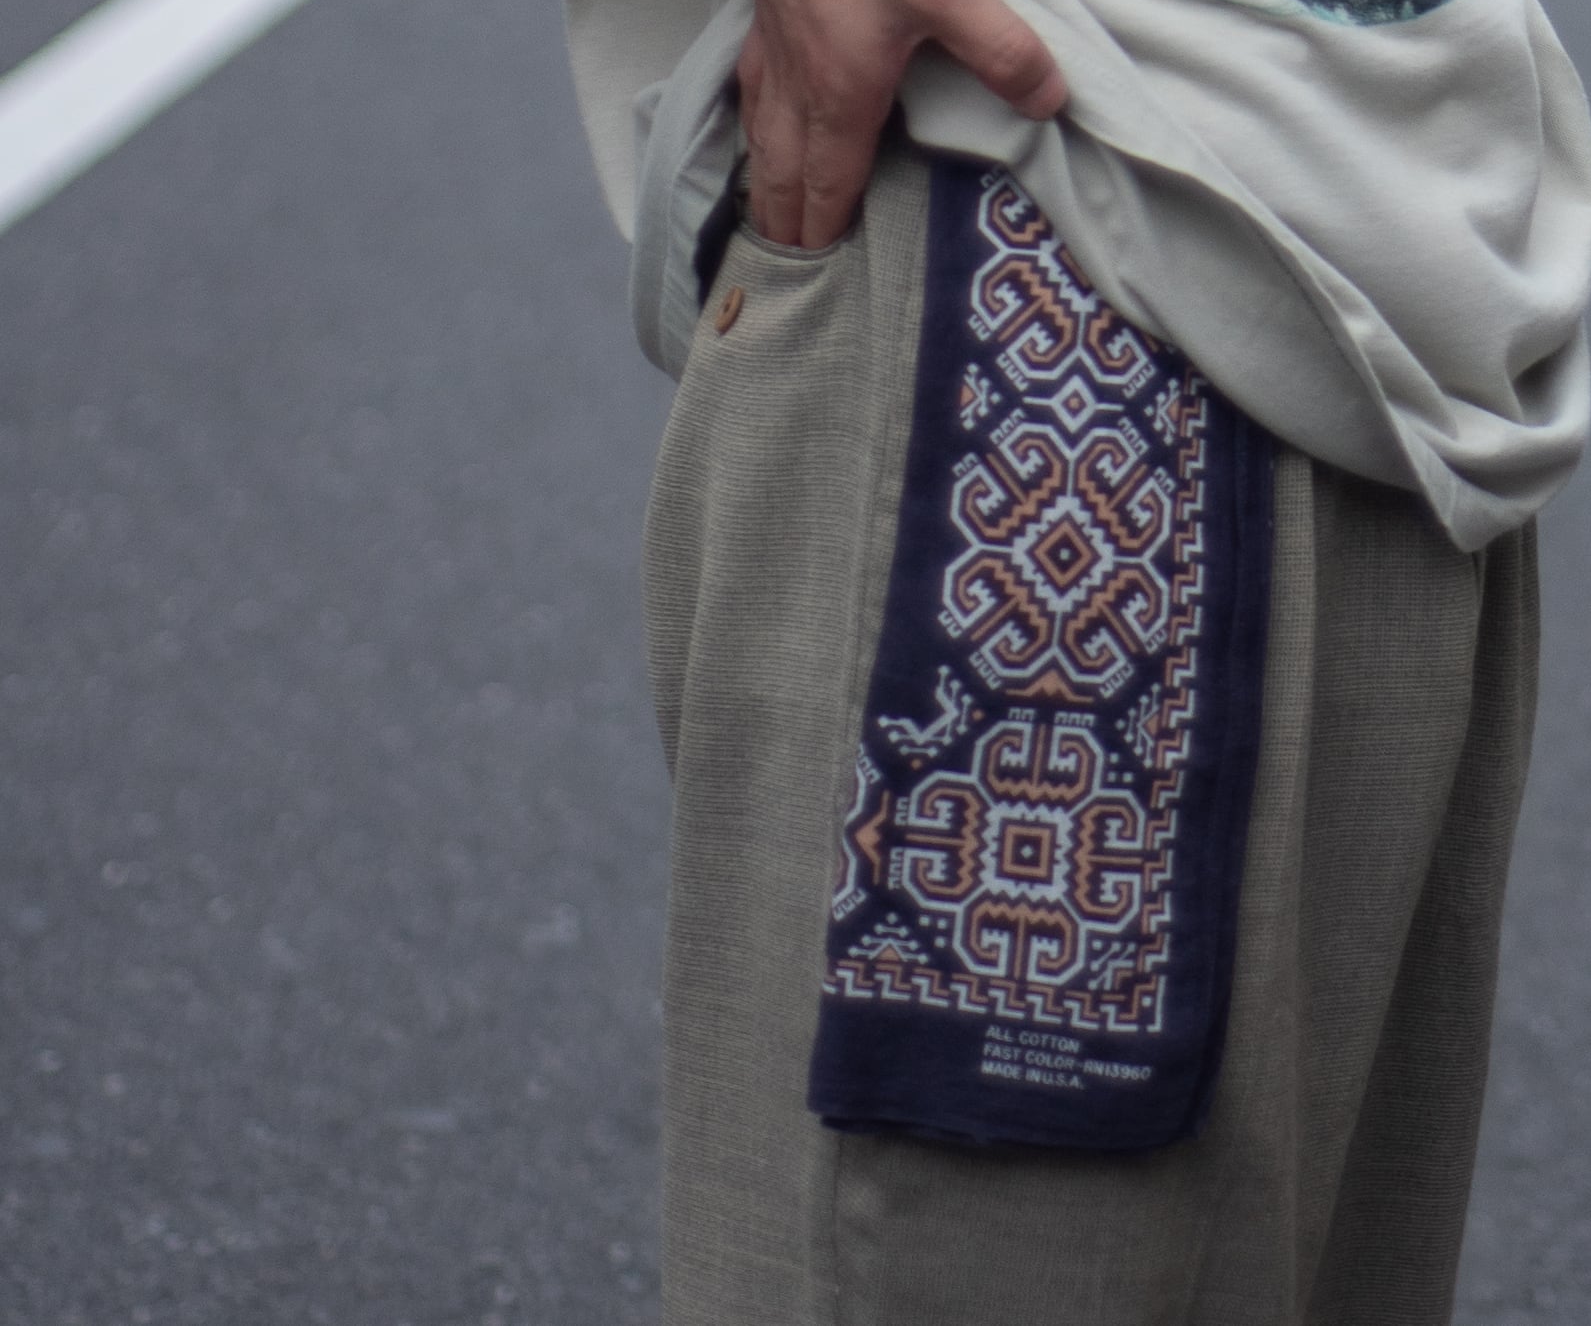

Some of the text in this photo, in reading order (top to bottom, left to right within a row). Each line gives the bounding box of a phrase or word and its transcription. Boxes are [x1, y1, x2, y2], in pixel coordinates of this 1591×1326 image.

[983, 1042, 1020, 1061] FAST
[985, 1025, 1081, 1054] ALL COTTON
[981, 1060, 1085, 1090] MADE IN U.S.A.
